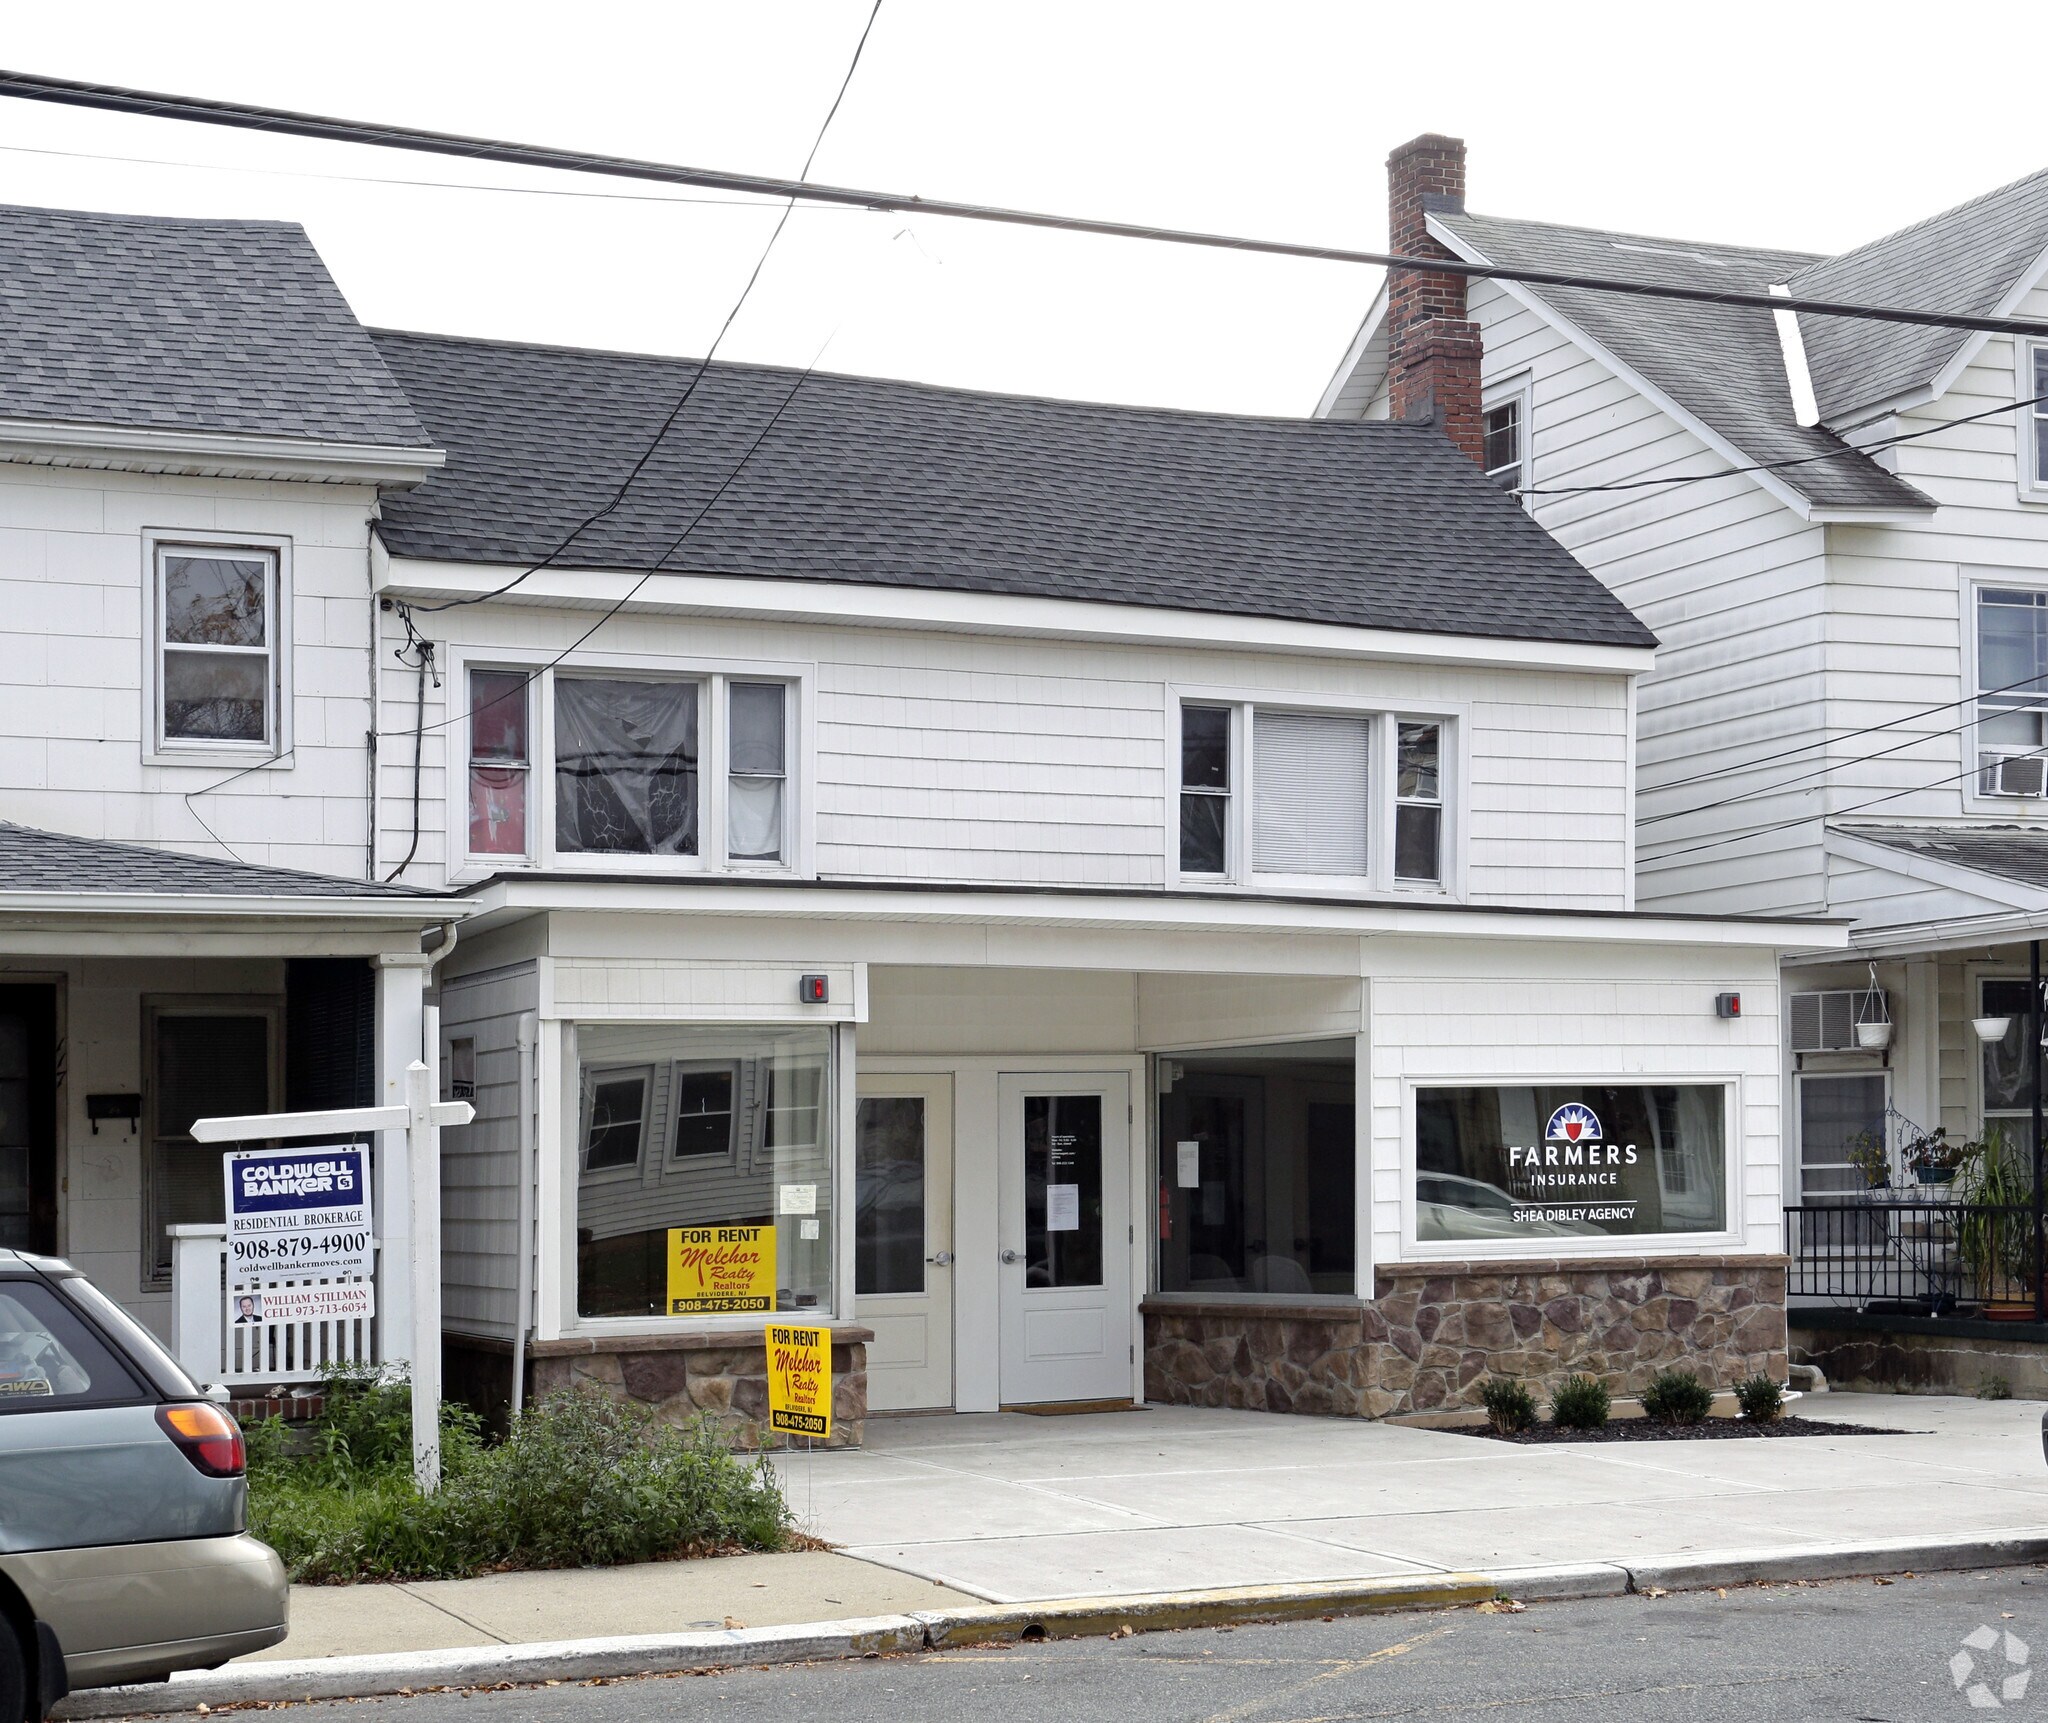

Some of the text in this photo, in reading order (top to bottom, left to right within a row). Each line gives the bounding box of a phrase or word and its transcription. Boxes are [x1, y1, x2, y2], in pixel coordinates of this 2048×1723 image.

[1510, 1145, 1637, 1166] FARMERS
[242, 1161, 353, 1181] COLDWELL
[244, 1177, 332, 1197] BANKER
[1532, 1173, 1616, 1186] INSURANCE
[234, 1211, 363, 1230] RESIDENTIAL BROKERAGE
[1513, 1207, 1635, 1222] SHEA DIBLEY AGENCY
[682, 1229, 760, 1243] FOR RENT
[234, 1233, 365, 1260] 908-879-4900
[239, 1258, 362, 1273] coldwellbankermoves.com
[681, 1244, 761, 1286] Melchor
[710, 1266, 755, 1282] Realty
[714, 1282, 750, 1290] Realtors
[263, 1290, 366, 1305] WILLIAM STILLMAN
[678, 1299, 764, 1311] 908-475-2050
[264, 1302, 367, 1318] CELL 973-713-6054
[772, 1329, 819, 1347] FOR RENT
[775, 1348, 822, 1397] Melchor
[0, 1381, 48, 1391] AWD
[792, 1374, 819, 1396] Realty
[795, 1393, 815, 1404] Realtors
[776, 1413, 823, 1431] 908-475-2050
